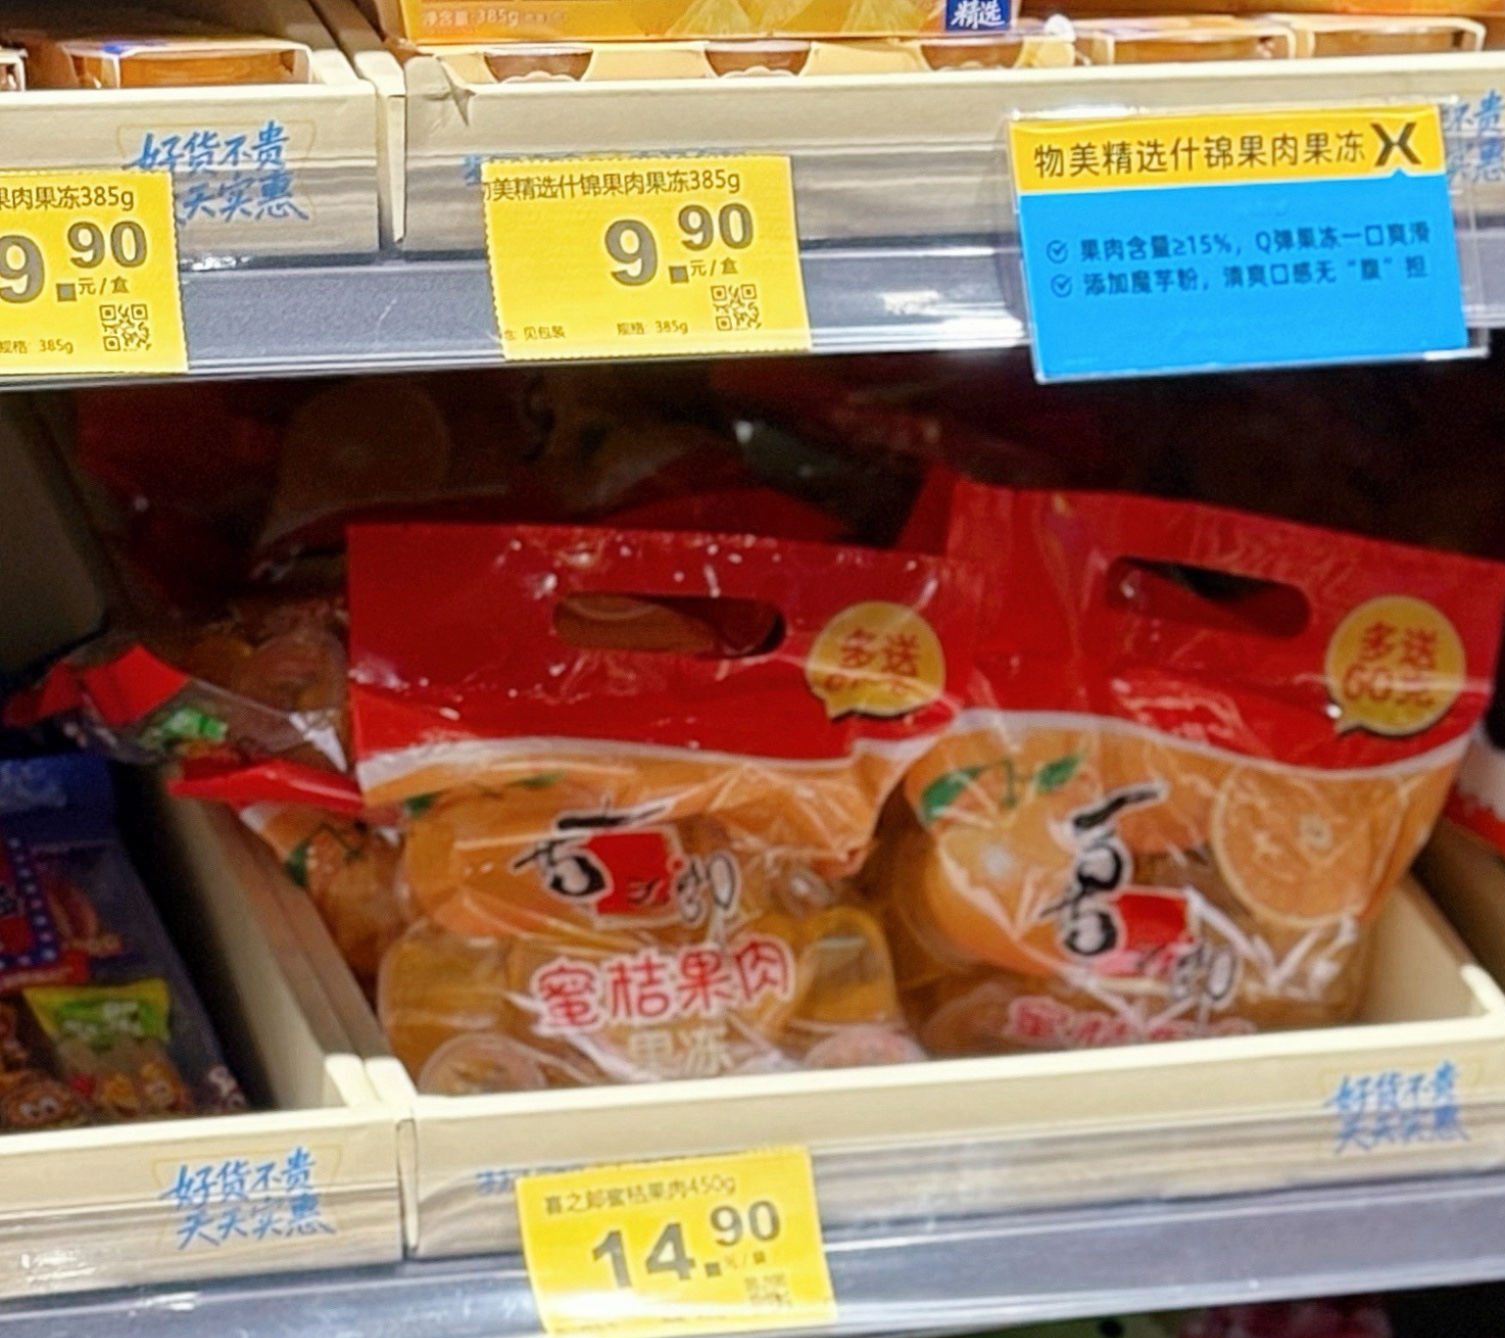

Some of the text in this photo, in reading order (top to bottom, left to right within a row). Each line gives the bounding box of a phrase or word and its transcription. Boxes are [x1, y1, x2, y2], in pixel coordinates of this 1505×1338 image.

[122, 120, 288, 170] 好货不贵
[1034, 130, 1366, 178] 物美精选什锦果肉果冻
[178, 171, 308, 225] 天实惠
[604, 203, 754, 286] 9.90
[159, 1146, 316, 1209] 好货不贵
[176, 1193, 336, 1250] 天天实惠
[591, 1200, 781, 1290] 14.90
